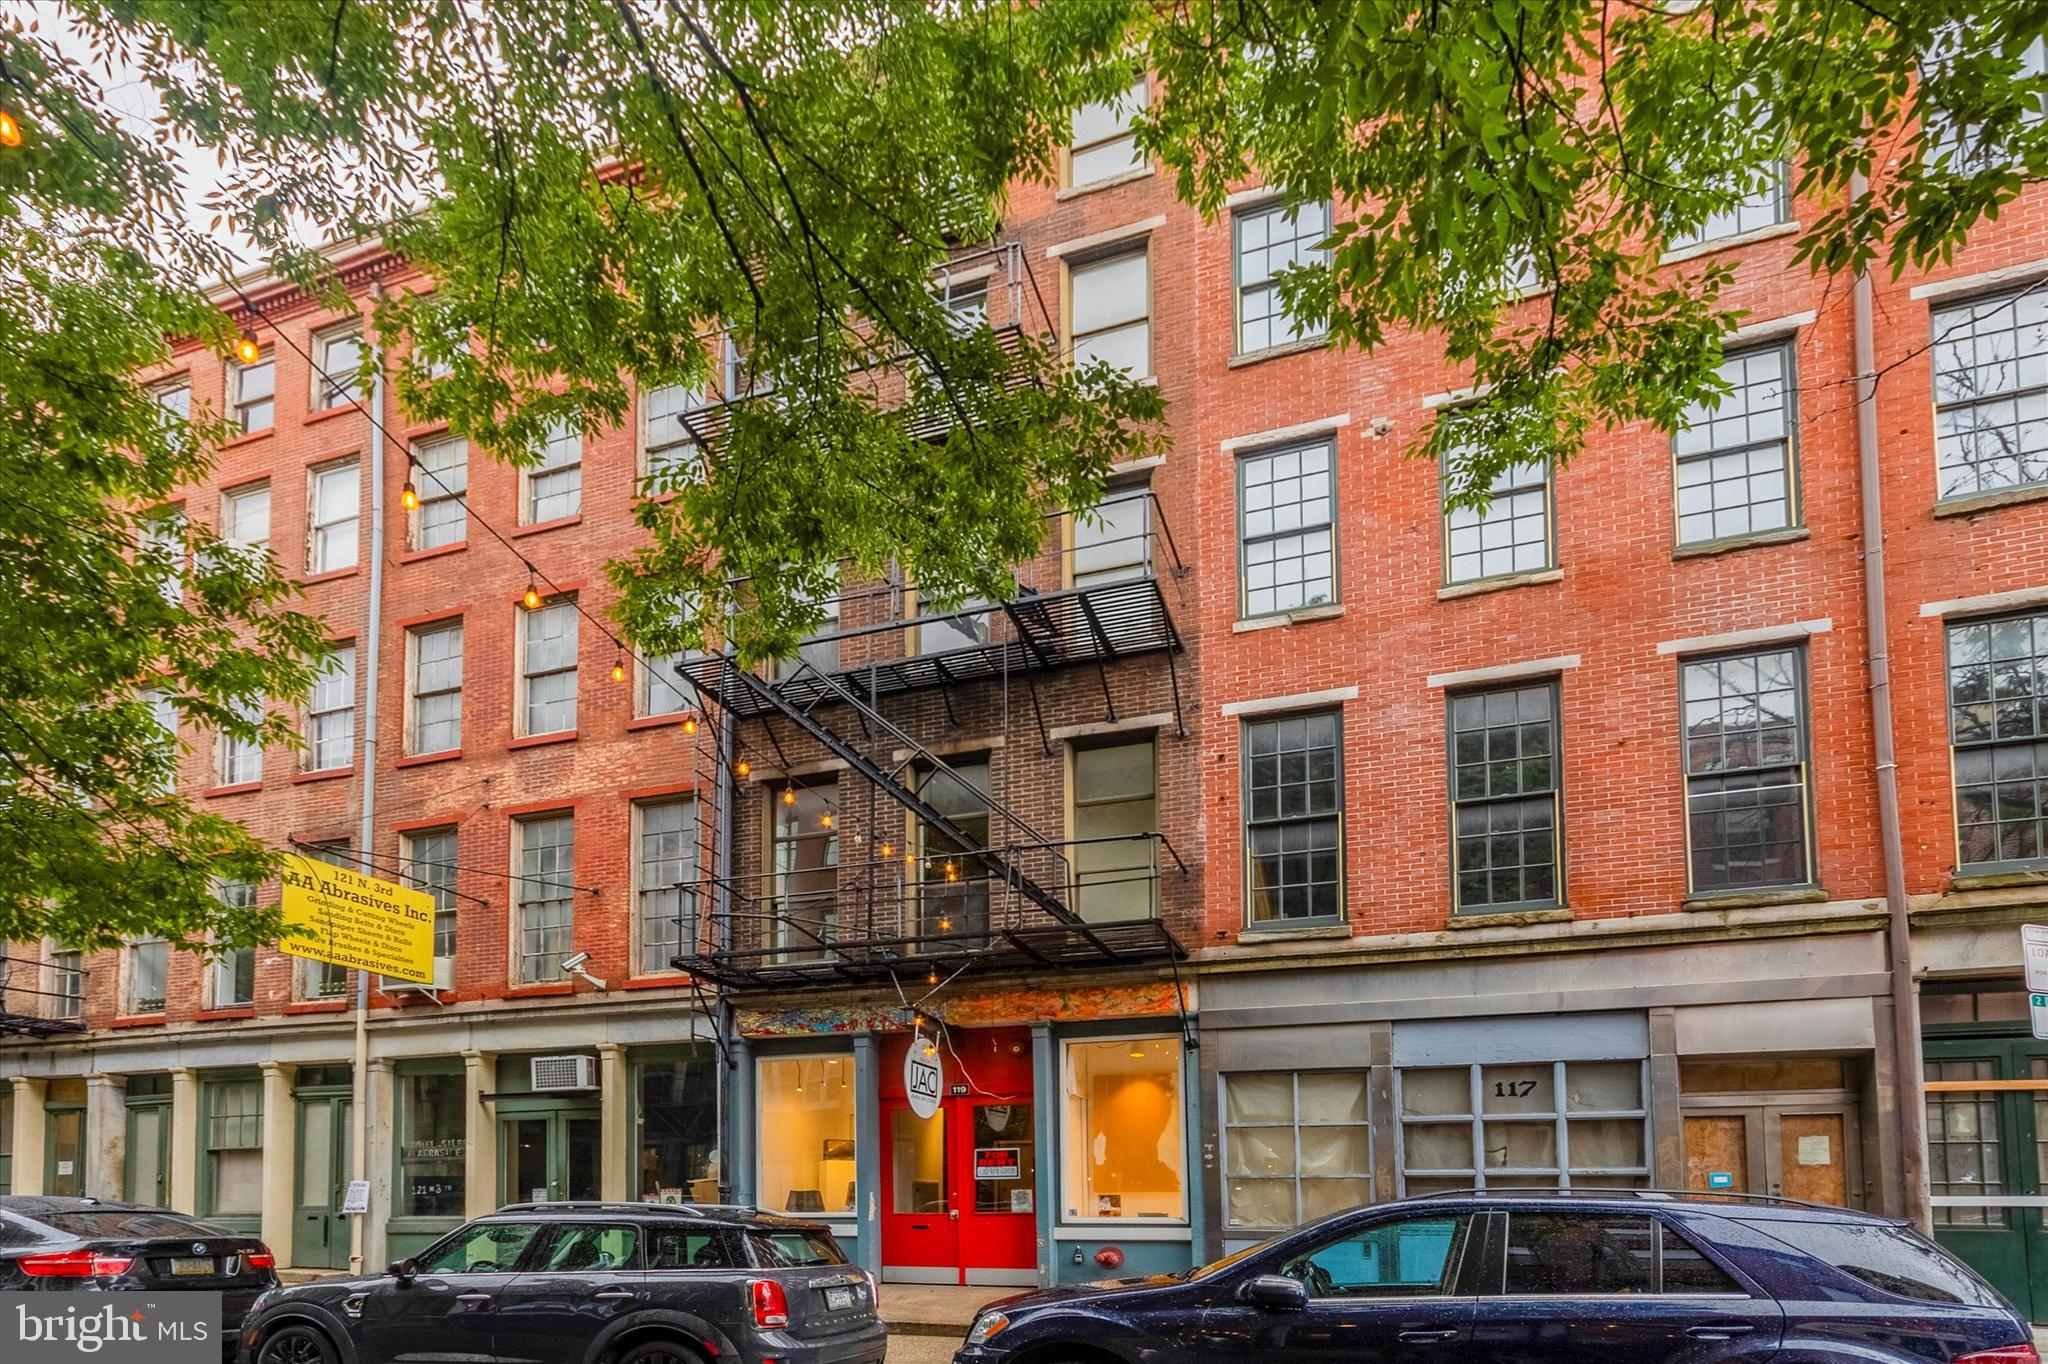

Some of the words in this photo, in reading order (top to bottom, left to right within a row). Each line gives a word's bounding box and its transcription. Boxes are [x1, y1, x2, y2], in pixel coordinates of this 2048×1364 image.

[288, 871, 315, 891] AA
[319, 880, 400, 915] Abrasives
[404, 904, 432, 923] Inc.
[334, 870, 353, 885] 121
[358, 878, 370, 890] N.
[374, 883, 393, 897] 3rd
[306, 895, 346, 912] Grinding
[356, 908, 386, 923] Cutting
[388, 917, 415, 930] Wheels
[318, 908, 353, 923] Sanding
[355, 917, 374, 928] Belts
[385, 925, 405, 936] Discs
[309, 915, 355, 933] Sandpaper
[357, 927, 383, 939] Sheets
[394, 936, 412, 946] Rolls
[341, 933, 371, 946] Wheels
[381, 942, 402, 953] Discs
[289, 943, 426, 979] www.aaabrasives.com
[372, 949, 414, 965] Specialties
[913, 1066, 936, 1094] JAC
[953, 1086, 967, 1094] 119
[1495, 1080, 1537, 1098] 117
[978, 1159, 1016, 1167] RENT
[411, 1185, 427, 1195] 121
